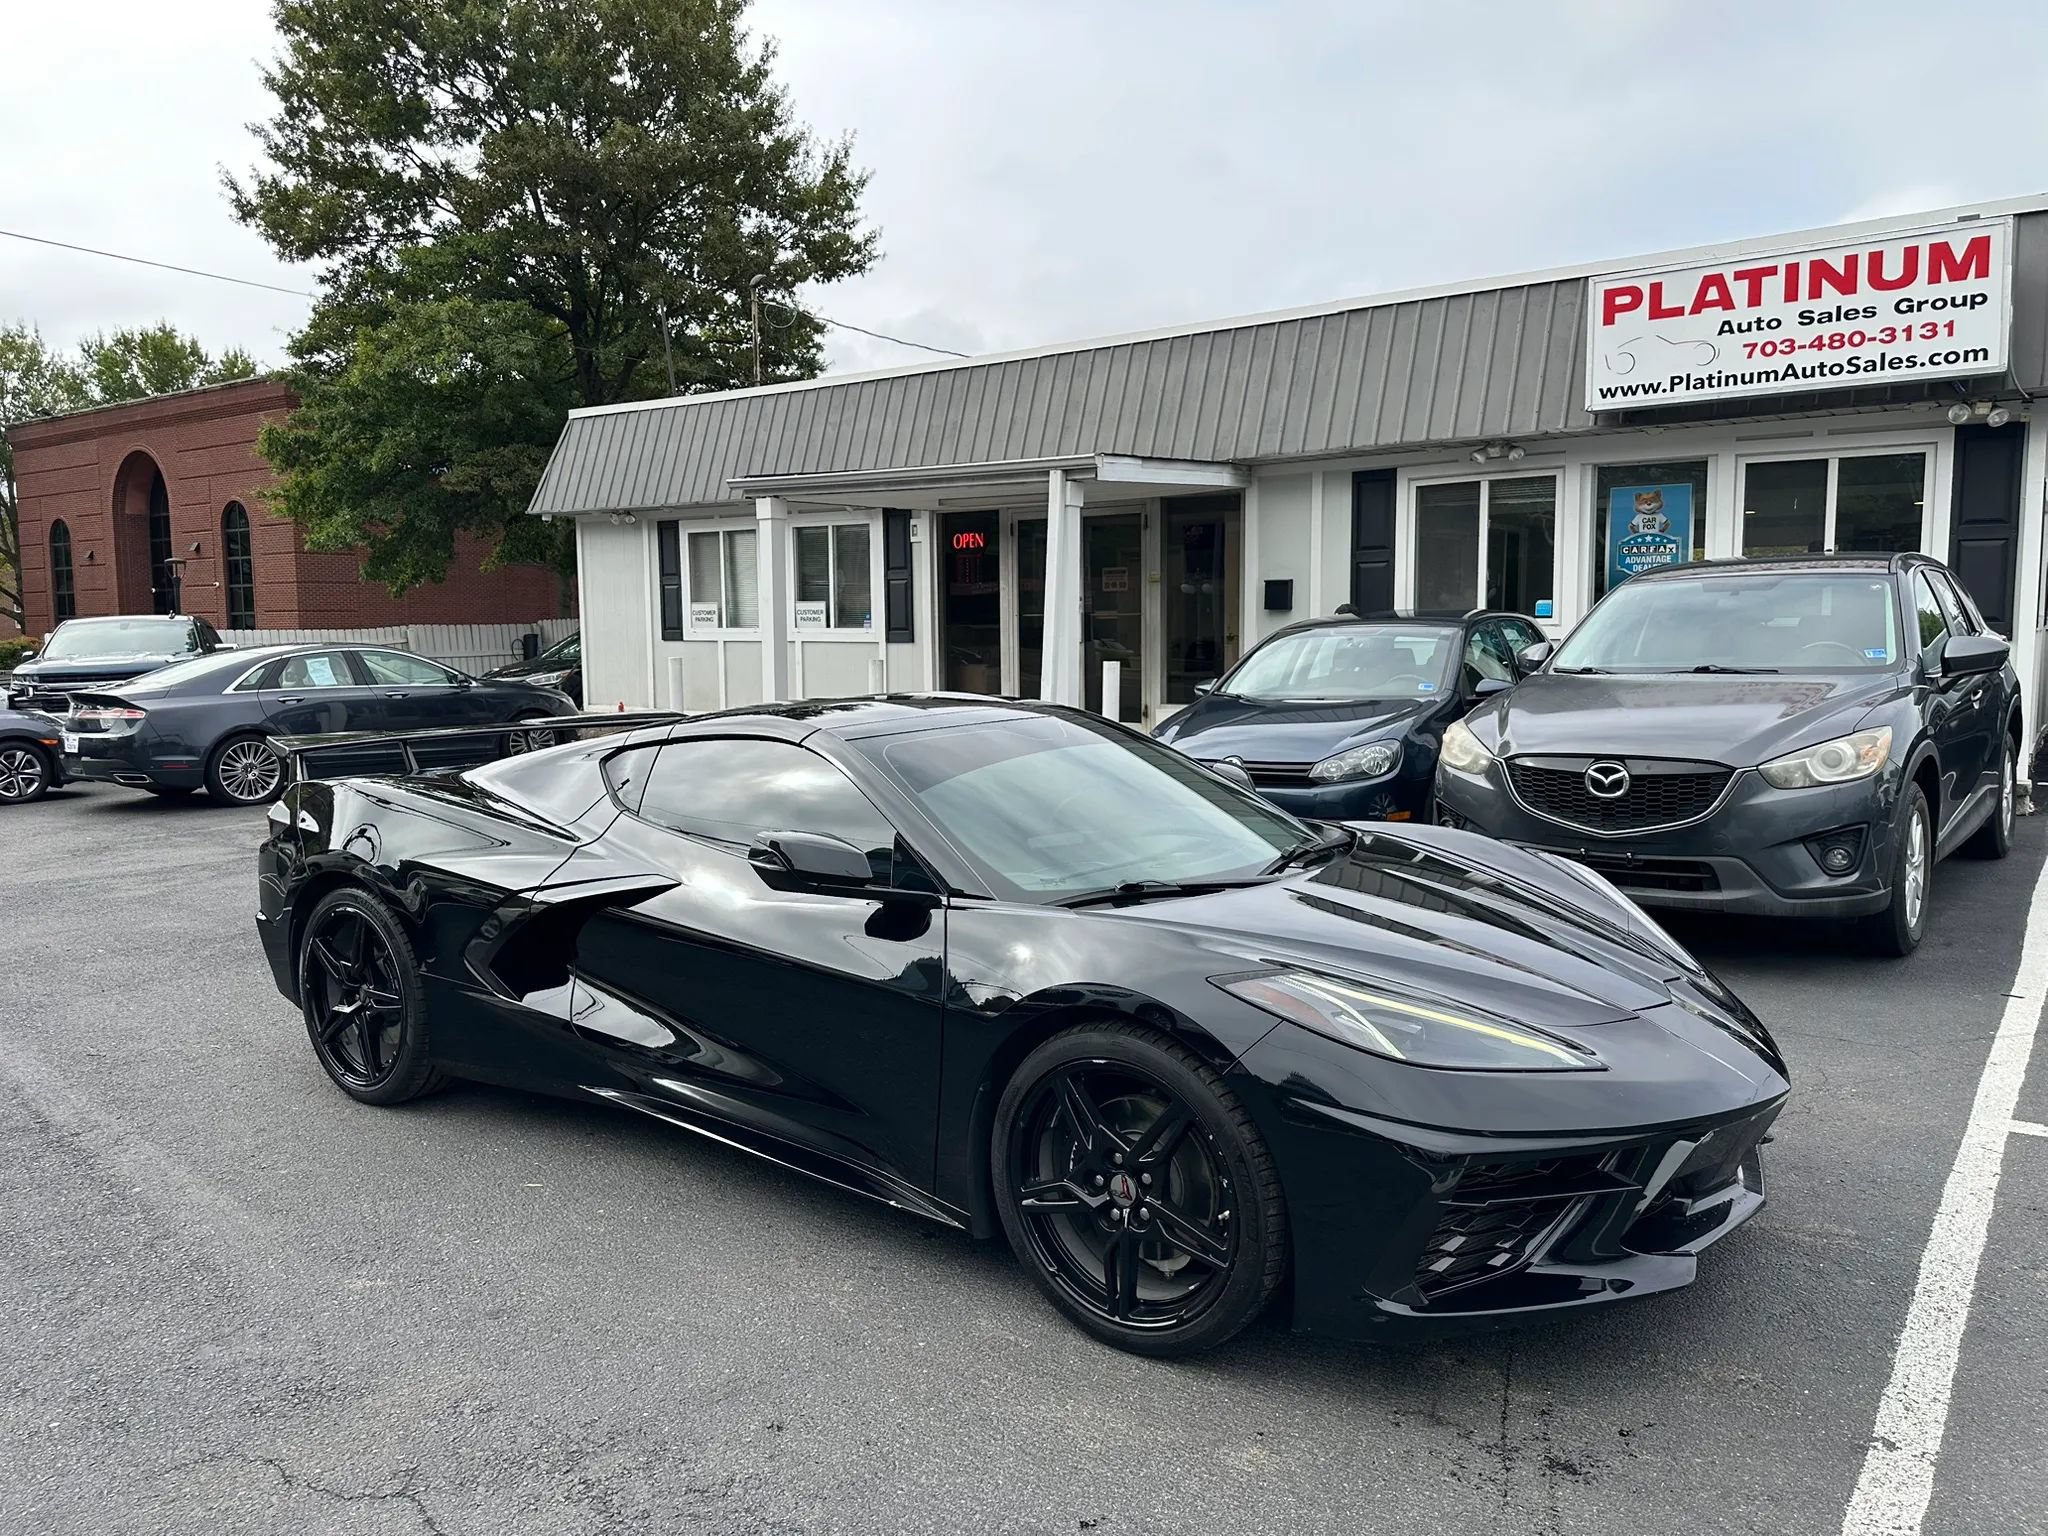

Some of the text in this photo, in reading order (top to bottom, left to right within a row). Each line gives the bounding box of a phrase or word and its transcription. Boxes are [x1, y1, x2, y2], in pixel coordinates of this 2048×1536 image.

[1602, 235, 1991, 327] PLATINUM
[1717, 291, 1989, 337] Auto Sales Group
[1742, 319, 1956, 360] 703-480-3131
[1599, 344, 1989, 399] www.PlatinumAutoSales.com
[953, 533, 984, 549] OPEN
[1622, 544, 1676, 554] CARFAX
[1625, 555, 1672, 564] ADVANTAGE
[1632, 564, 1662, 572] DEA
